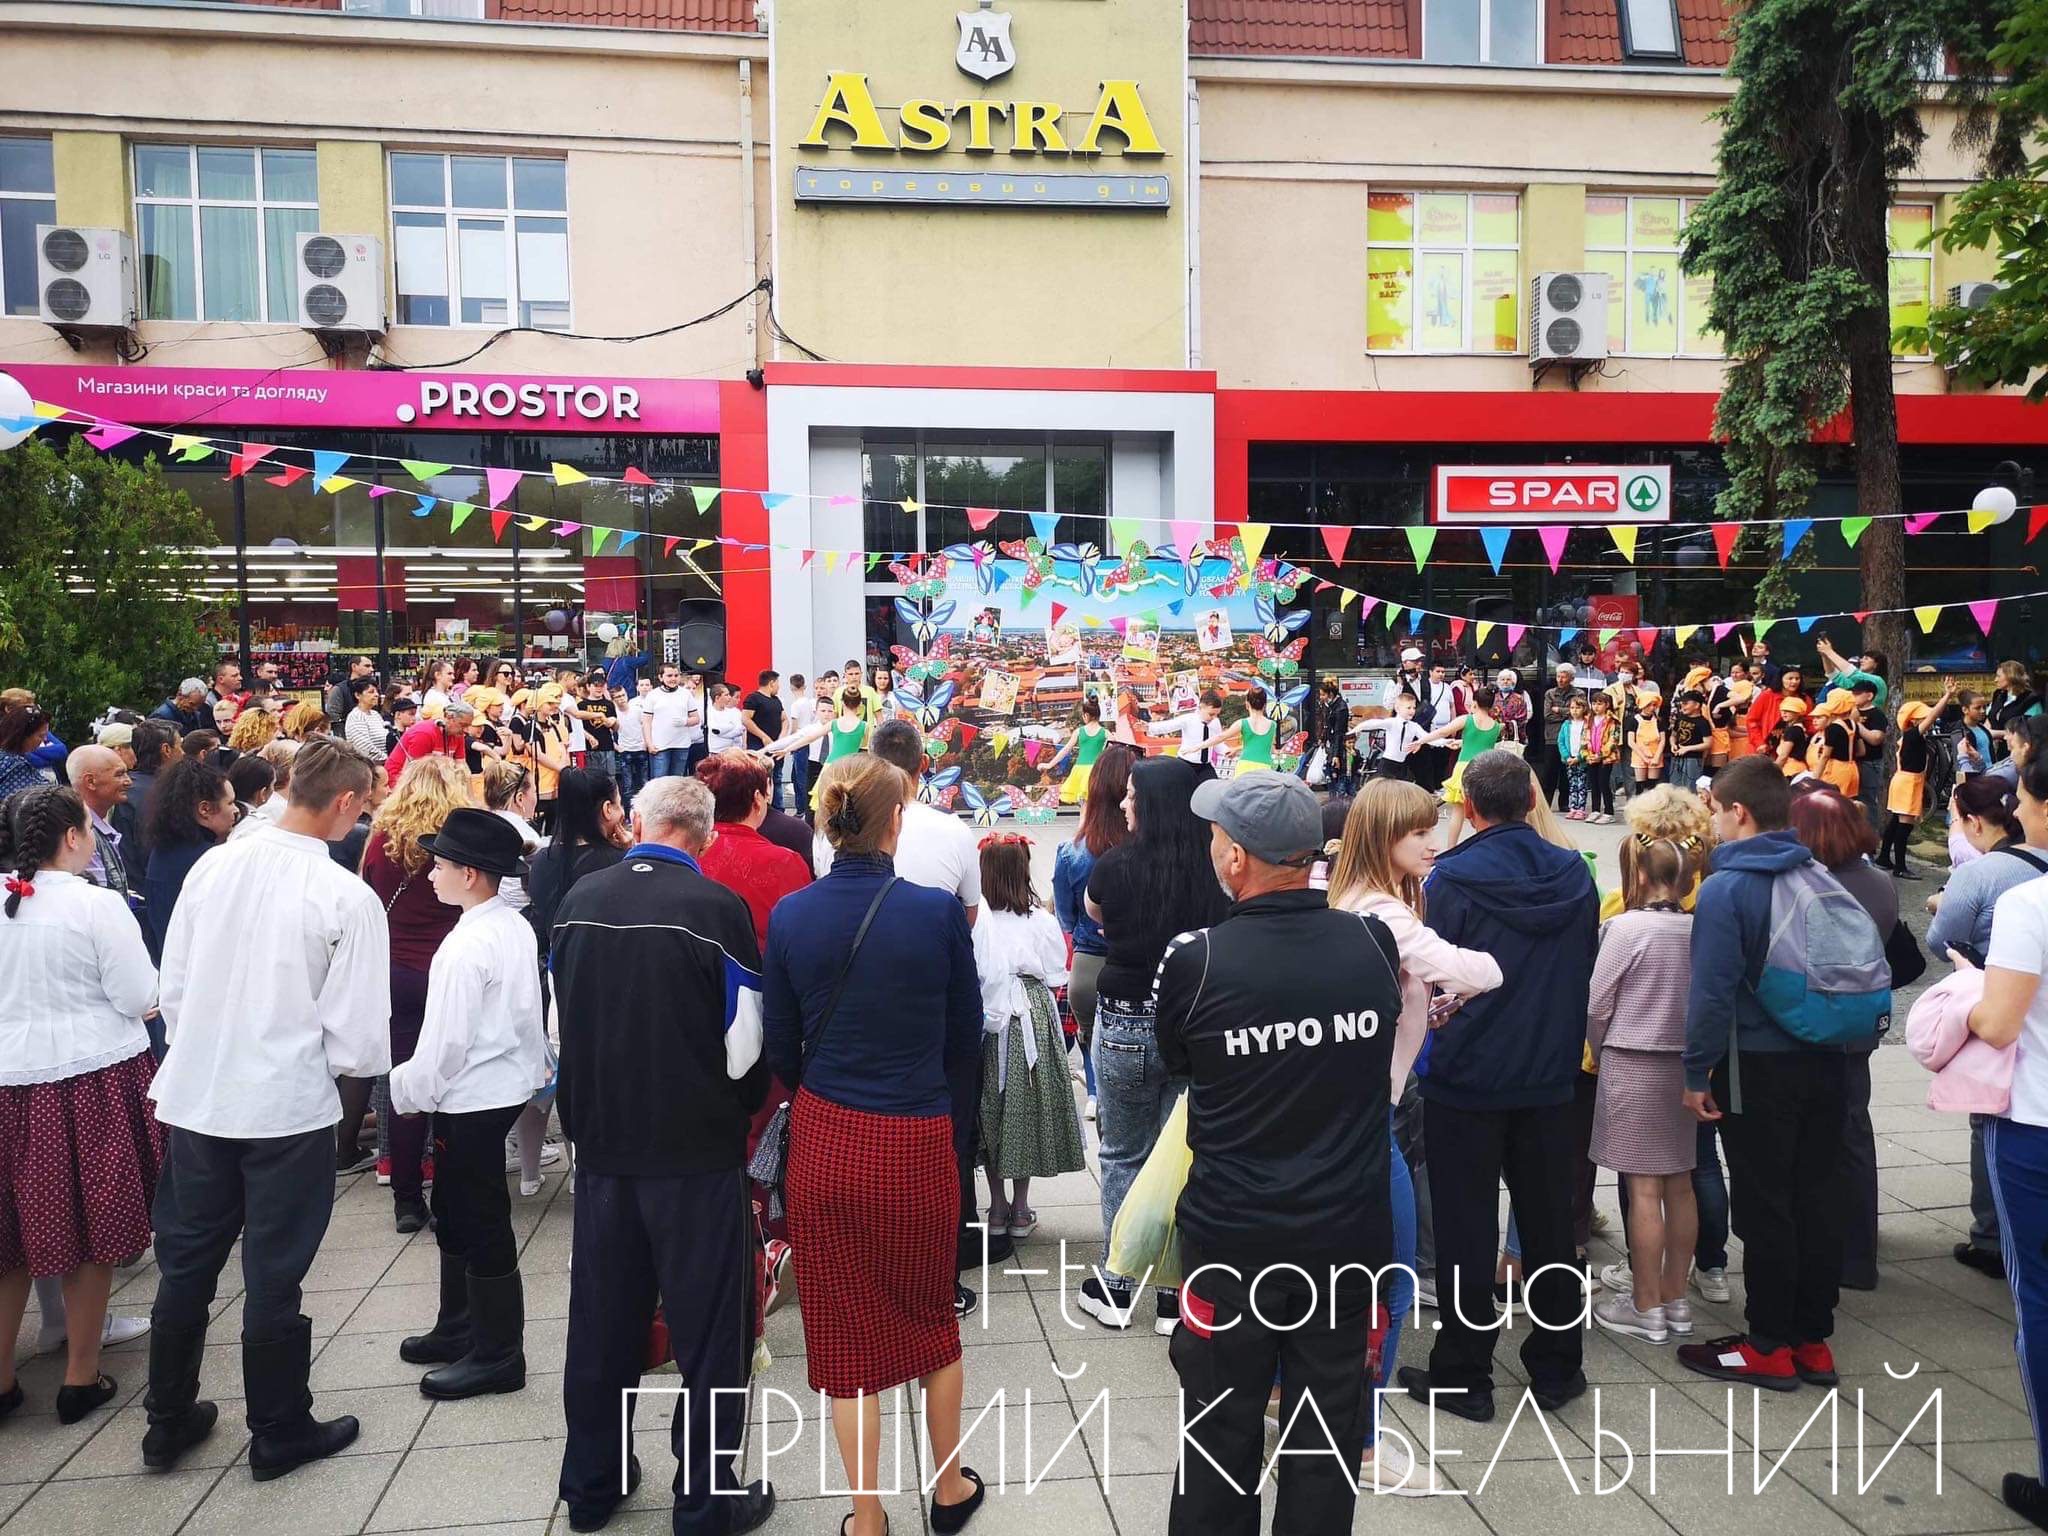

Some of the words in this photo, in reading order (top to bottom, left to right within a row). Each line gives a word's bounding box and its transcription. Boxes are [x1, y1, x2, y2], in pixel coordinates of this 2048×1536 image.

[77, 377, 168, 396] Магазини
[173, 383, 227, 398] краси
[231, 384, 249, 397] та
[254, 384, 328, 403] догляду
[1488, 481, 1617, 506] SPAR
[1224, 1017, 1323, 1056] HYPO
[1333, 1009, 1379, 1043] NO
